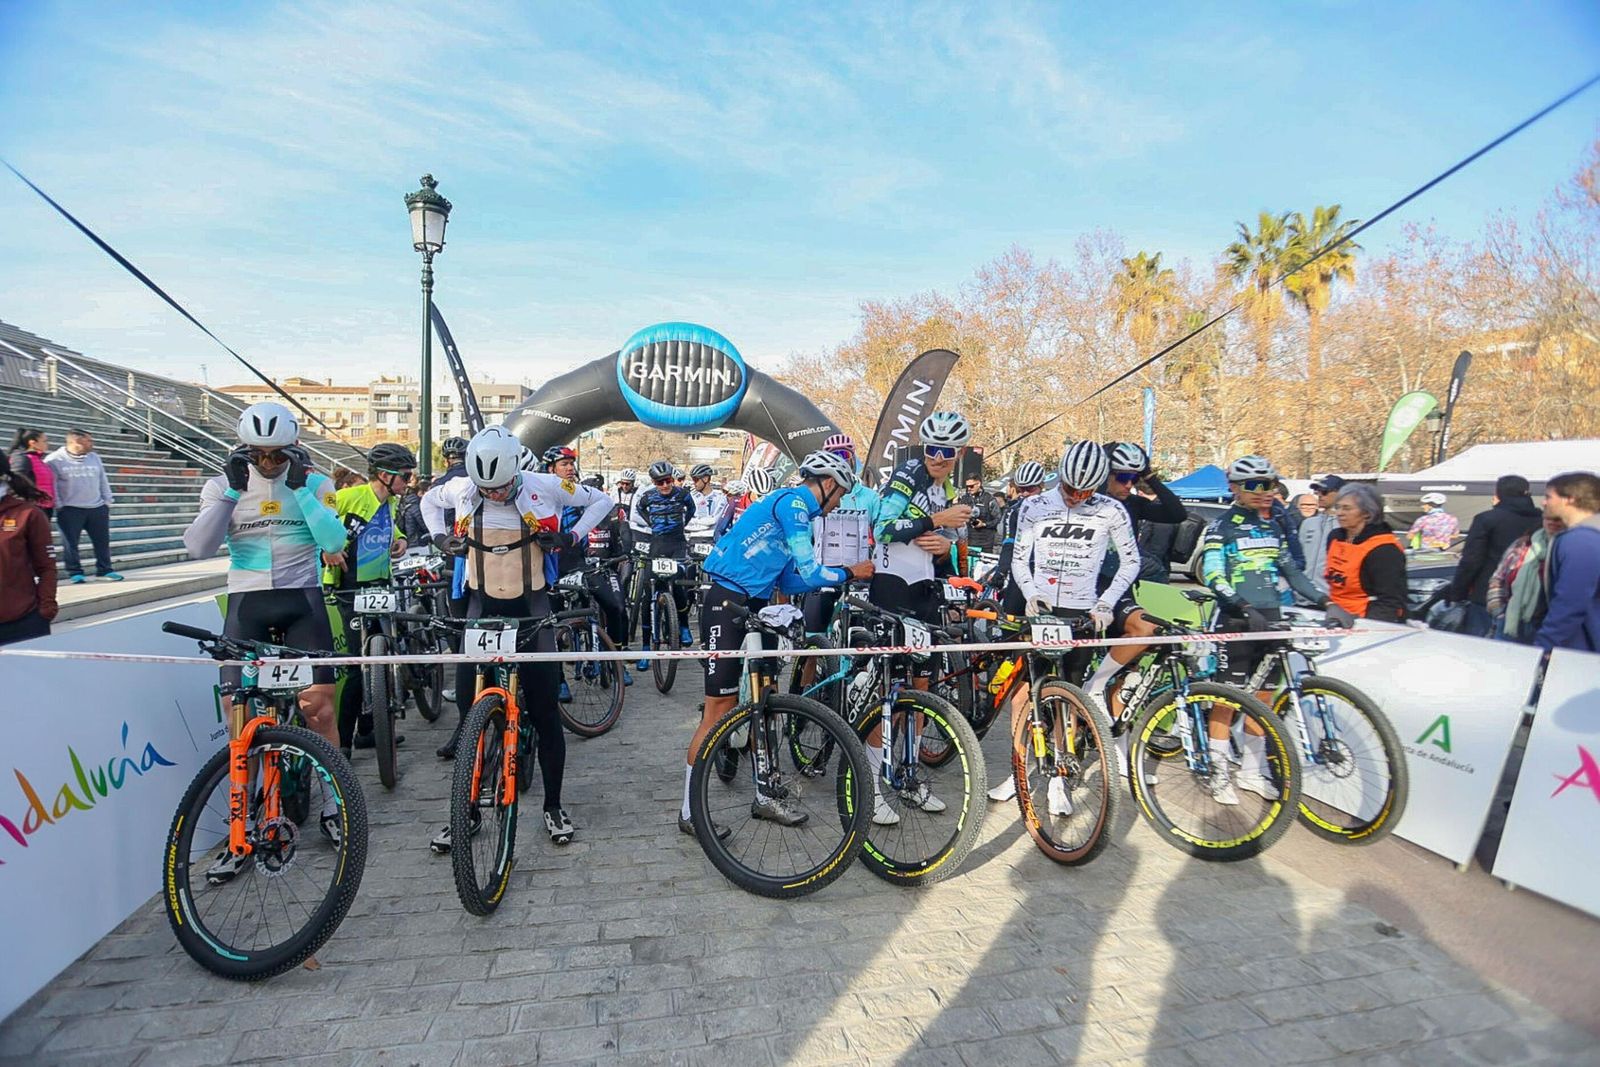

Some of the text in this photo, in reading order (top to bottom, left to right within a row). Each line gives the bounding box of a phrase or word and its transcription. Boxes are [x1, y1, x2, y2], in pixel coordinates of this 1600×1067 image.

[630, 361, 732, 386] GARMIN
[521, 408, 571, 424] garmin.com
[787, 424, 831, 440] garmin.com
[876, 378, 932, 486] ARMIN
[239, 519, 305, 530] megamo
[1041, 523, 1096, 541] KTM
[657, 561, 673, 571] 16-1
[1046, 559, 1081, 568] KOMETA
[362, 595, 389, 609] 12-2
[477, 631, 503, 651] 4-1
[911, 629, 925, 650] 5-2
[1042, 627, 1061, 641] 6-1
[708, 625, 721, 675] MOBLPA
[271, 664, 299, 682] 4-2
[1121, 664, 1158, 721] ORBEA
[706, 709, 747, 748] SCORPION
[248, 743, 343, 806] FULCRU
[230, 792, 244, 822] FOX
[168, 844, 179, 911] SCORPION
[805, 852, 844, 884] PIRELLI
